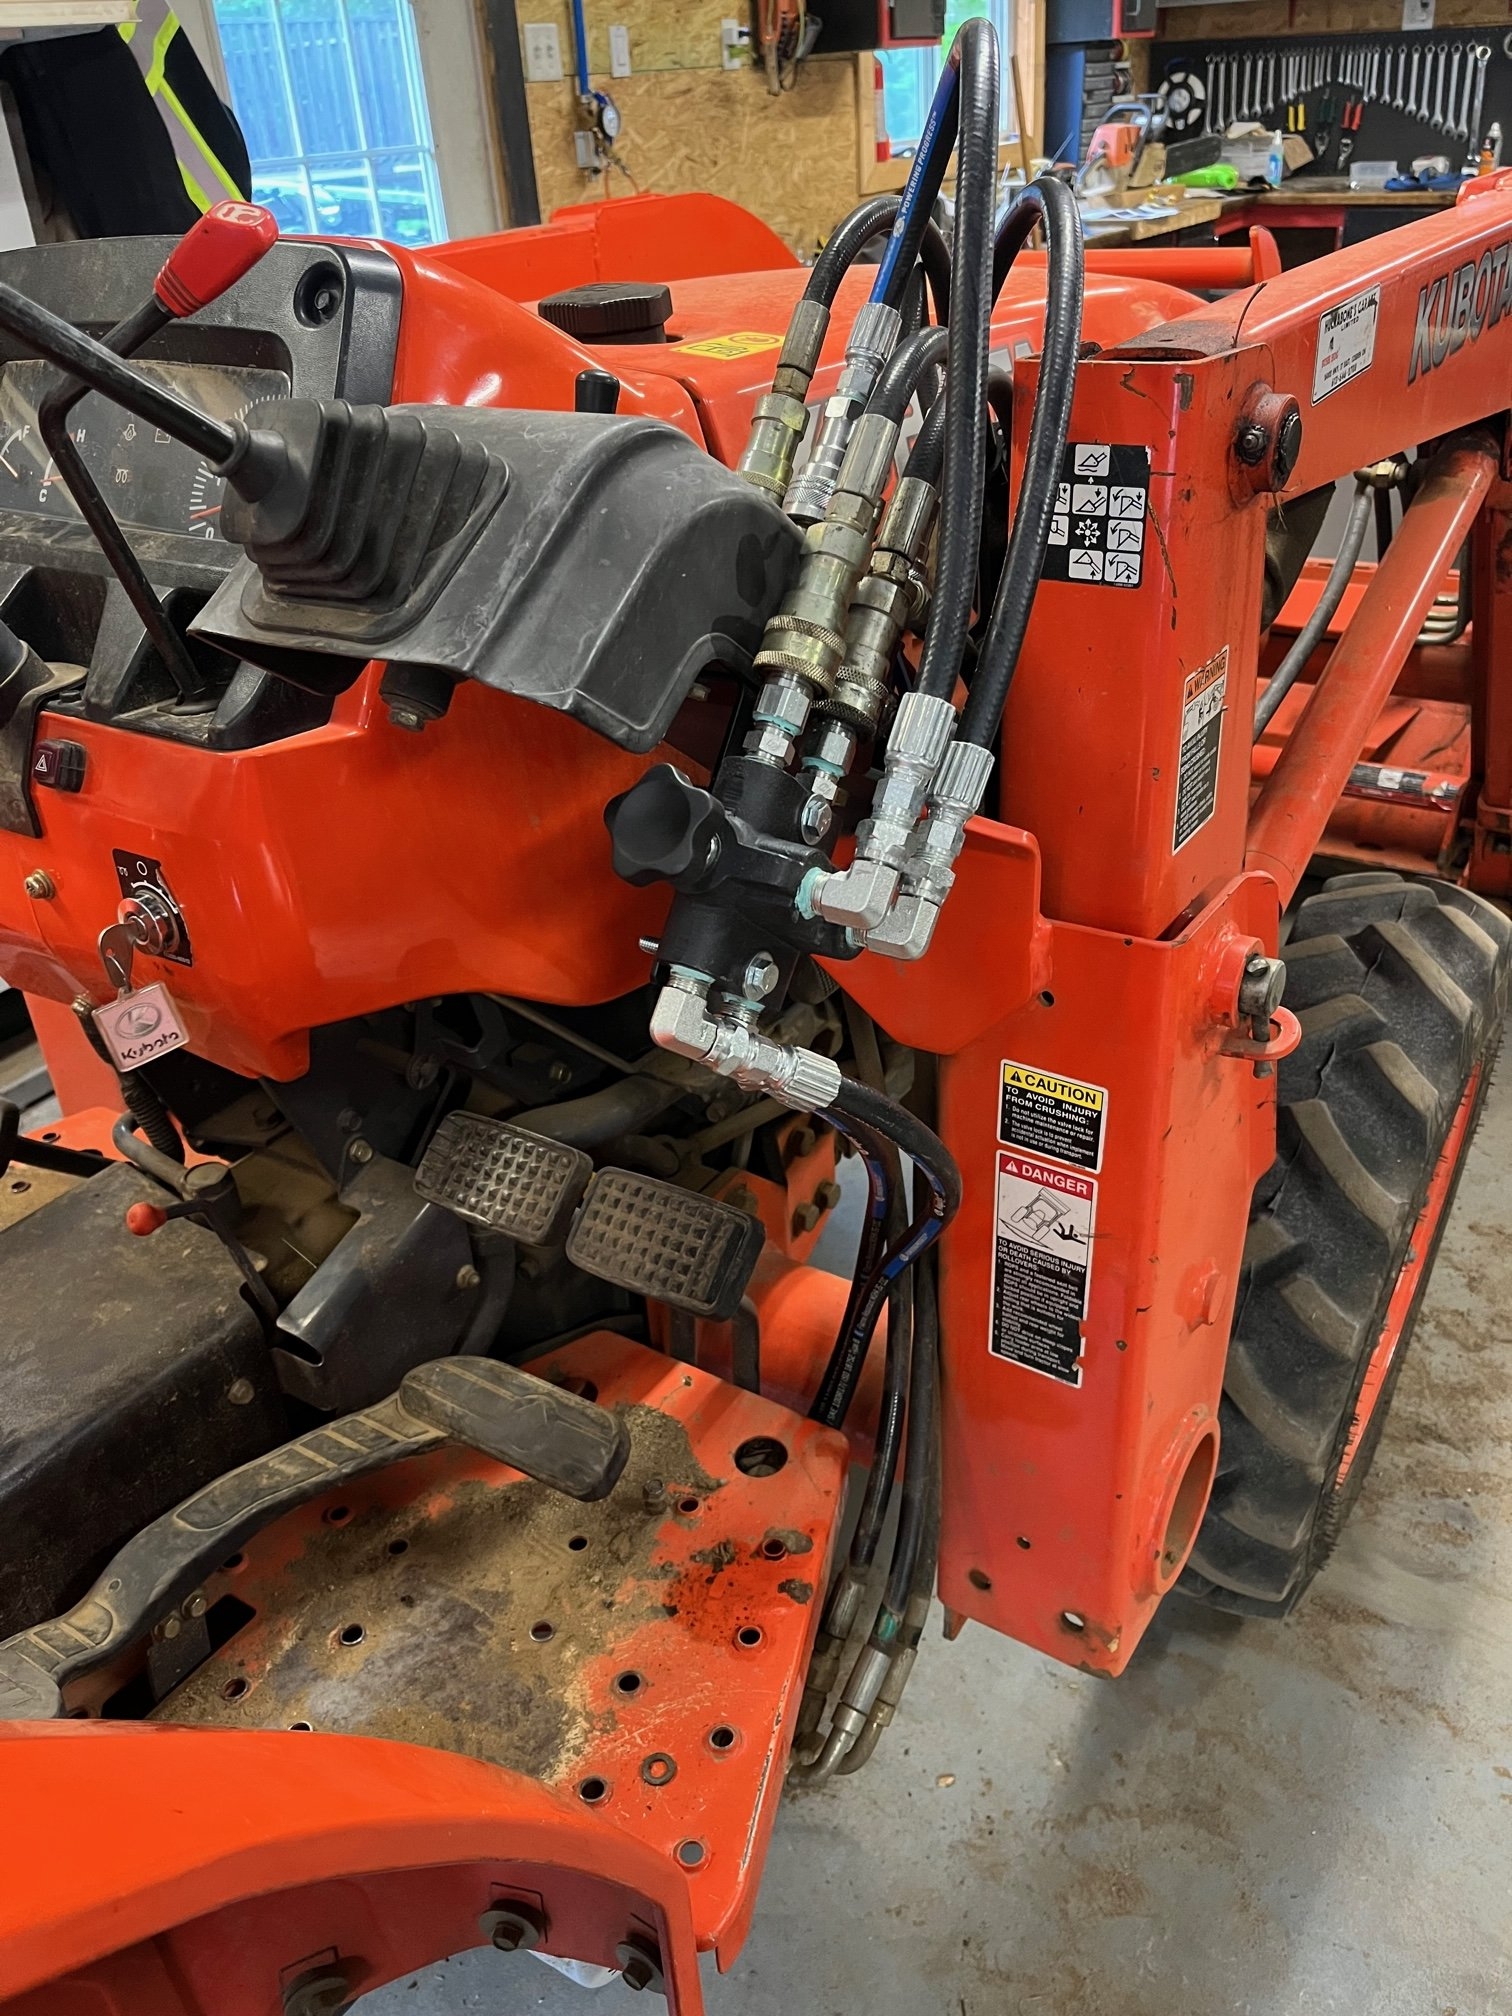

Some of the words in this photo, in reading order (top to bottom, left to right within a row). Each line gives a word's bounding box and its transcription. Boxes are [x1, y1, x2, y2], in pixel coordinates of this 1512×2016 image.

[901, 165, 922, 214] POWERING
[23, 425, 30, 439] F
[76, 429, 86, 443] H
[39, 489, 48, 502] C
[1006, 1086, 1019, 1095] TO
[1026, 1092, 1055, 1106] AVOID
[1063, 1103, 1098, 1119] INJURY
[1025, 1074, 1097, 1105] CAUTION
[1006, 1094, 1033, 1108] FROM
[1035, 1103, 1089, 1125] CRUSHING:
[1073, 1124, 1084, 1133] lock
[1021, 1165, 1088, 1195] DANGER
[998, 1245, 1008, 1253] OR
[1010, 1249, 1031, 1261] DEATH
[1033, 1257, 1060, 1272] CAUSED
[1009, 1242, 1029, 1254] AVOID
[1061, 1261, 1085, 1274] INJURY
